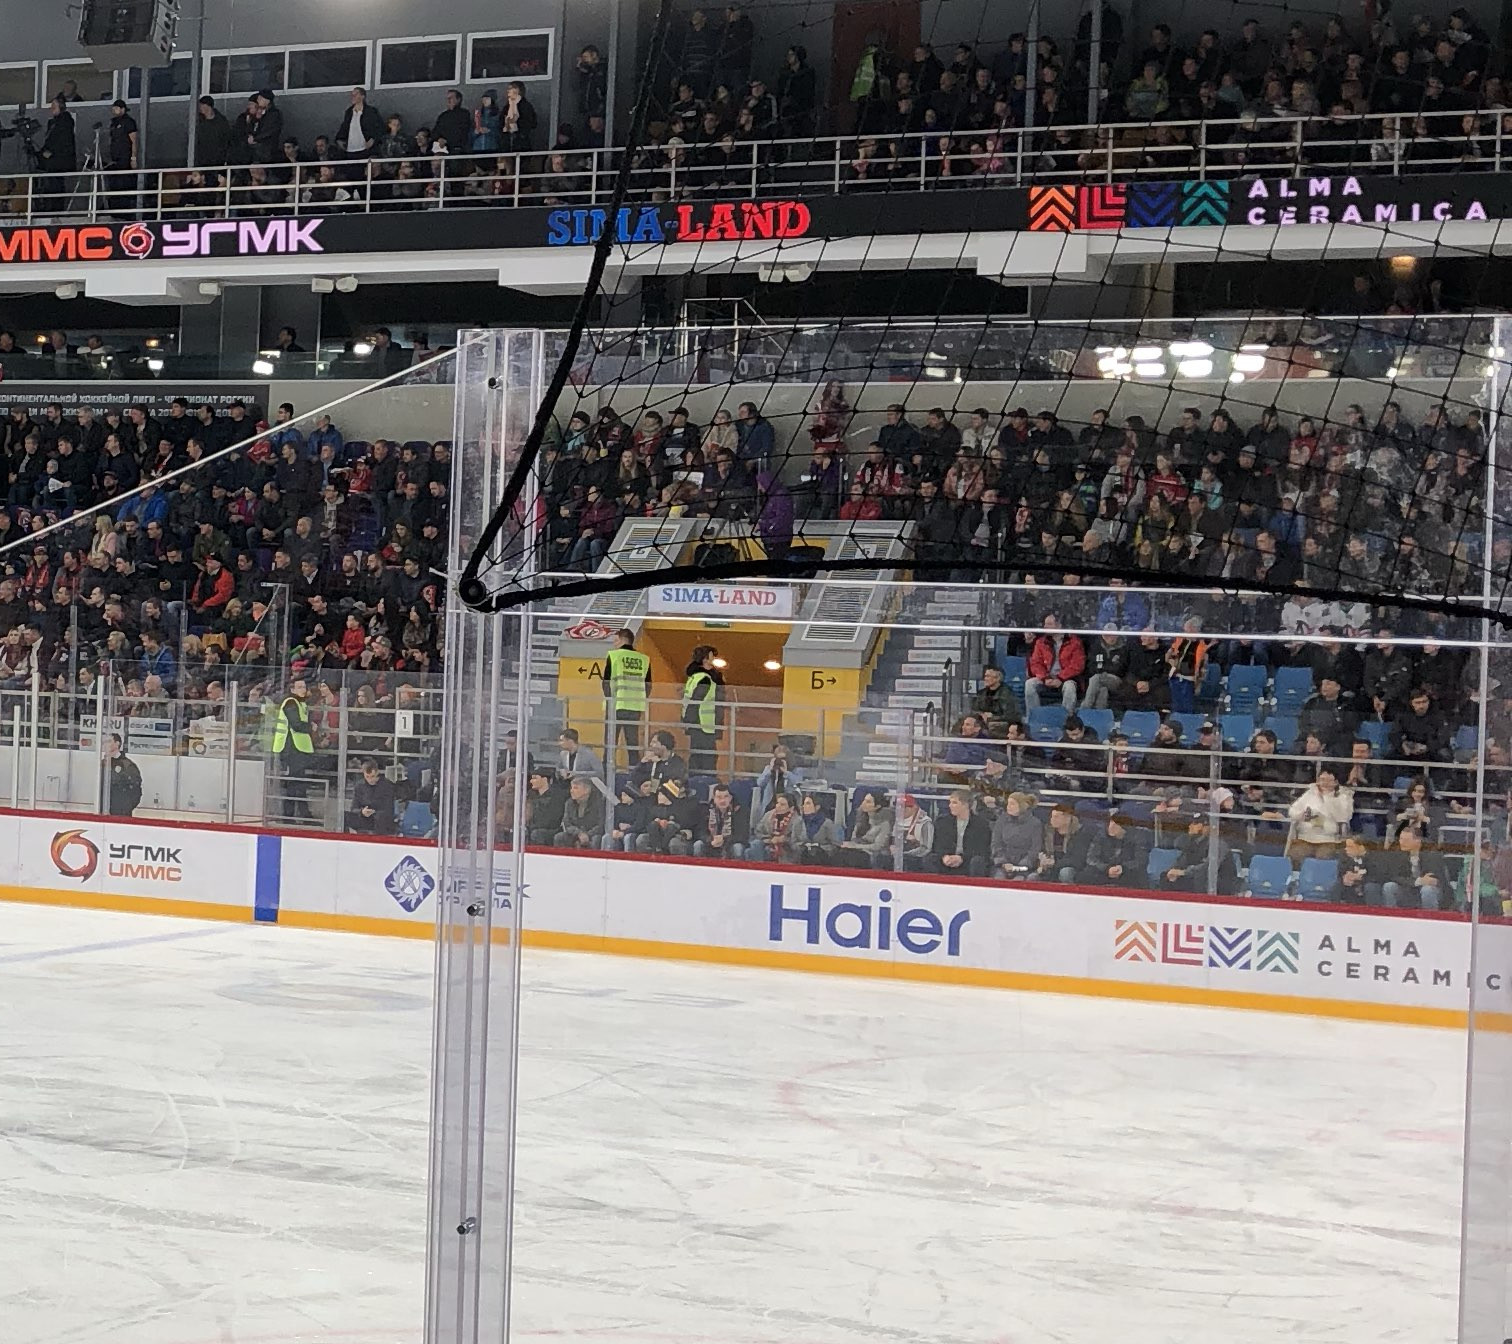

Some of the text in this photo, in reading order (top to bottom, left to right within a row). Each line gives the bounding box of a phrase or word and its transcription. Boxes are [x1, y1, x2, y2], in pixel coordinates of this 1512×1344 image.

[1248, 176, 1363, 199] ALMA
[1248, 201, 1487, 225] CERAMICA
[162, 218, 324, 255] УГМК
[662, 587, 777, 606] SIMA-LAND
[811, 671, 824, 690] Б
[109, 843, 183, 864] УГМК
[108, 862, 183, 882] UMMC
[768, 883, 972, 957] Haier
[1317, 934, 1421, 958] ALMA
[1317, 960, 1512, 991] CERAMIC
